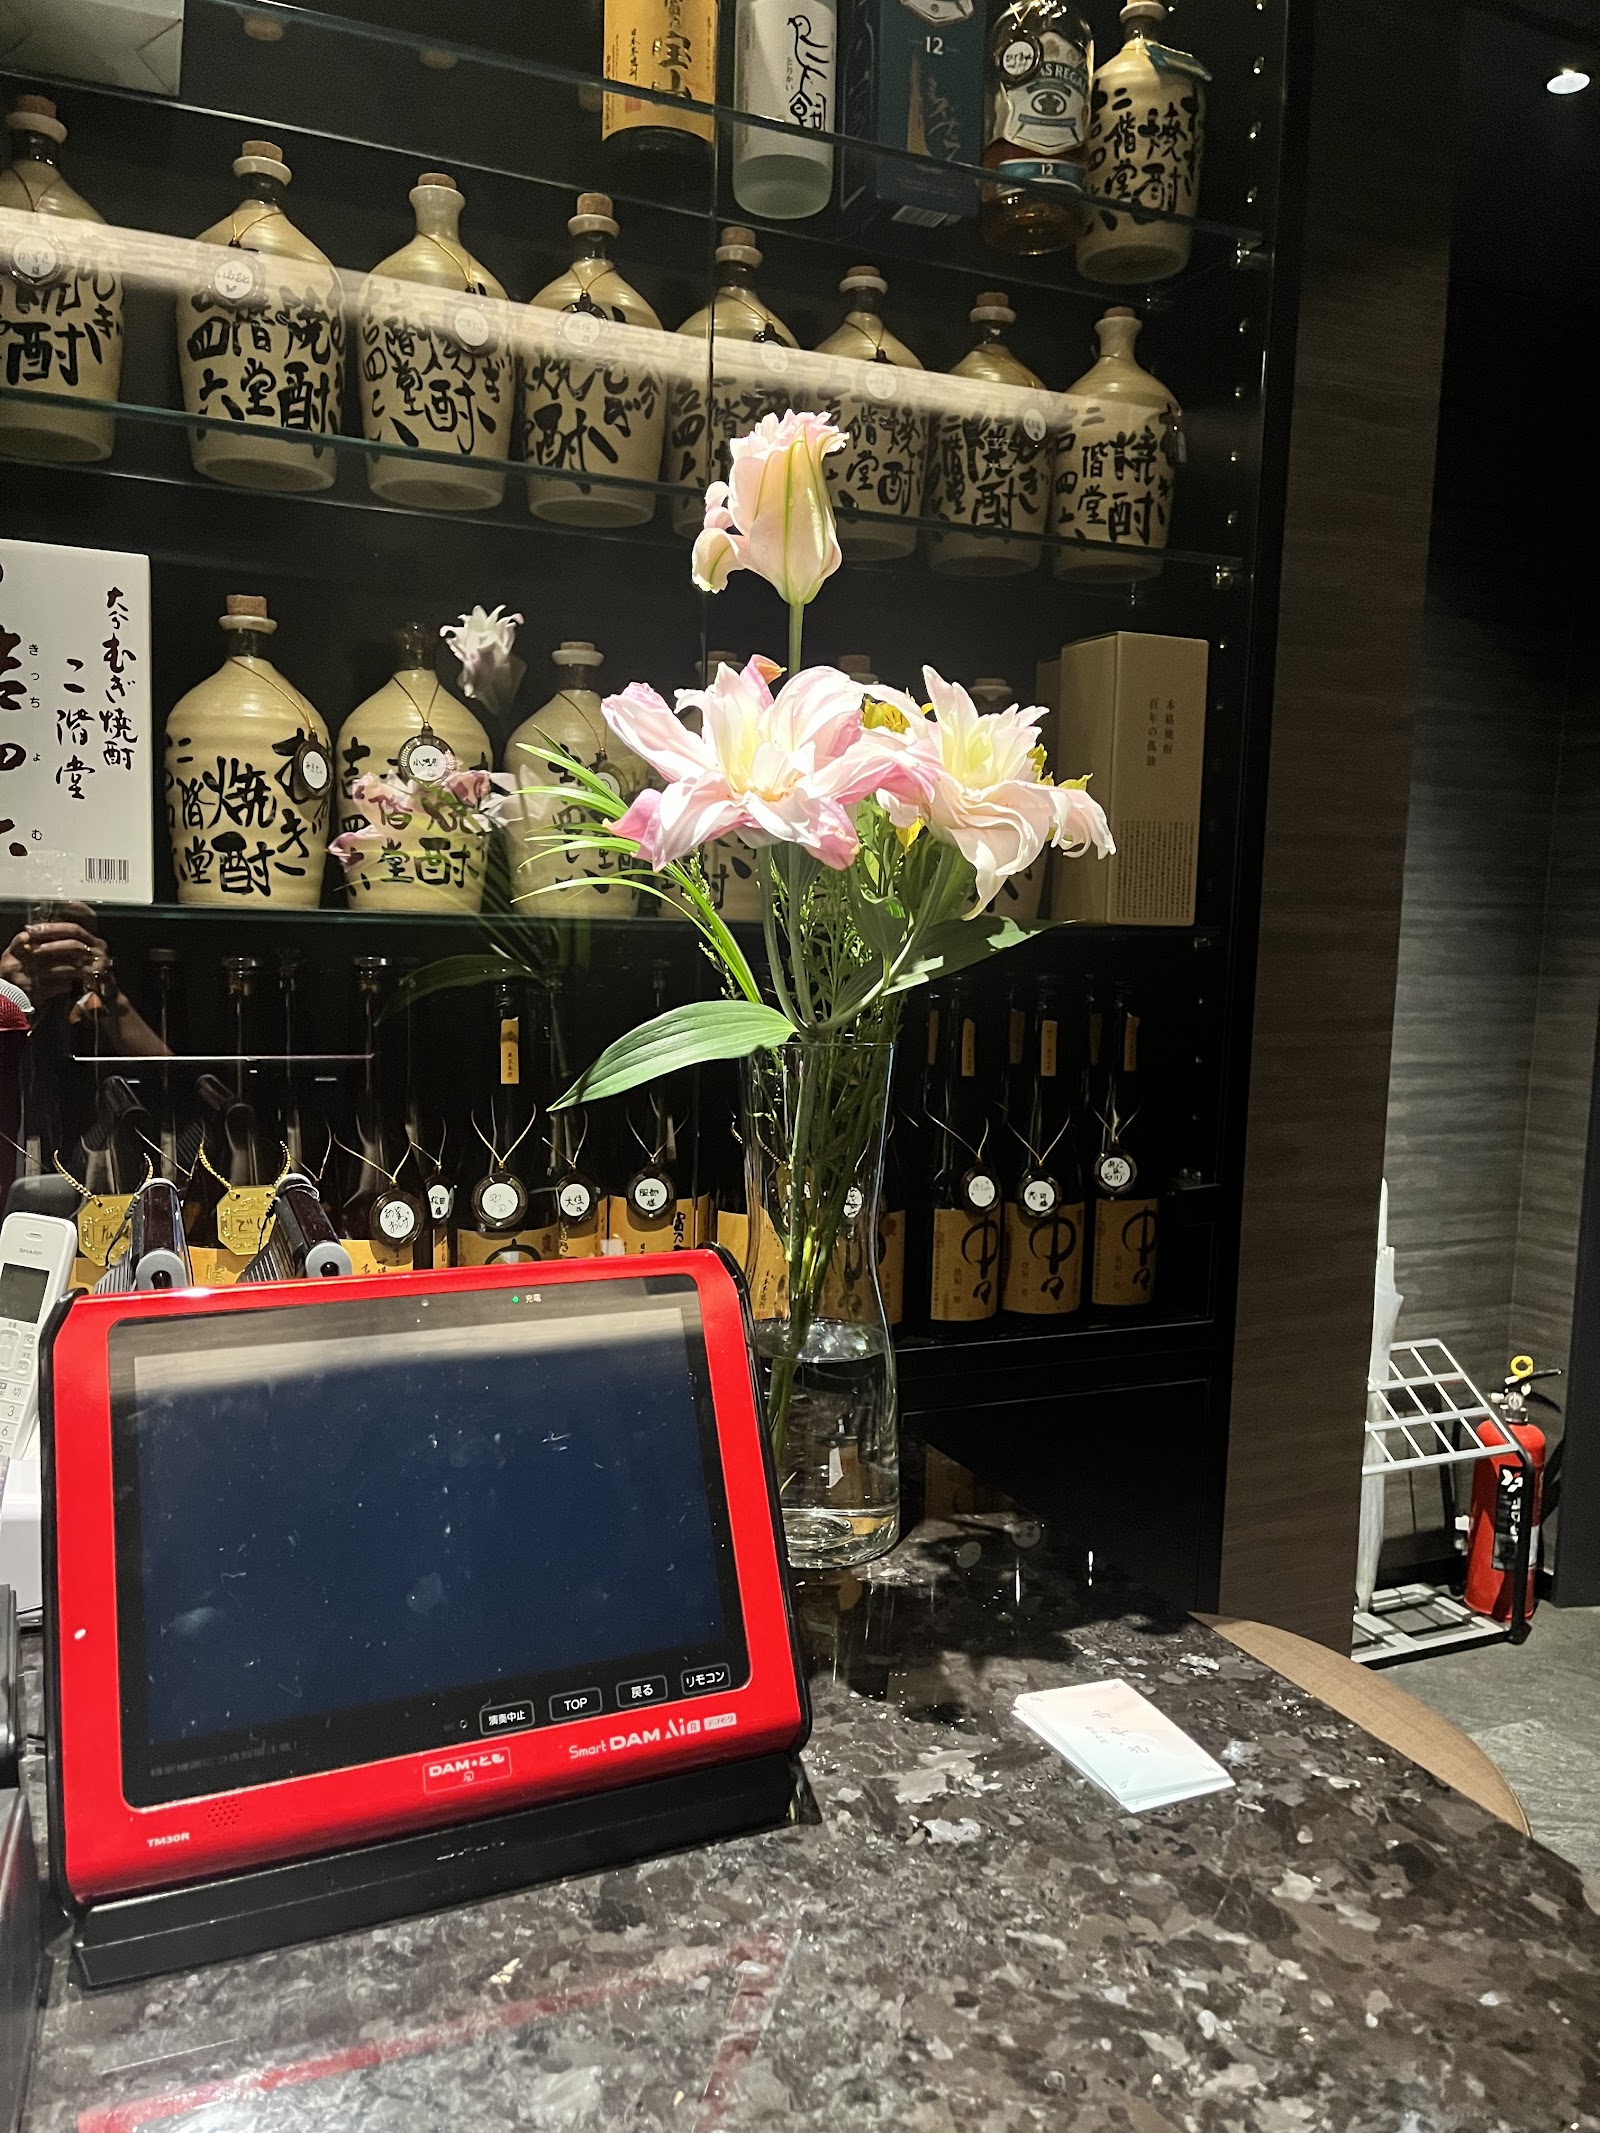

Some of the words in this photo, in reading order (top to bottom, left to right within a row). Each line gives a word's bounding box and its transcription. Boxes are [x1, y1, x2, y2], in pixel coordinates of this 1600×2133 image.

[926, 36, 944, 55] 12
[1041, 163, 1054, 176] 12
[99, 587, 138, 770] 大分むぎ焼酎
[55, 658, 96, 800] 二階堂
[202, 756, 277, 897] 焼酎
[18, 1248, 43, 1256] SHARP
[7, 1406, 15, 1417] 3
[1, 1425, 9, 1436] 6
[686, 1671, 725, 1688] リモコン
[631, 1684, 654, 1699] 戻る
[564, 1697, 588, 1711] TOP
[488, 1709, 526, 1726] 演奏中止
[569, 1742, 607, 1759] Smart
[609, 1729, 661, 1750] DAM
[146, 1832, 191, 1847] TM30R
